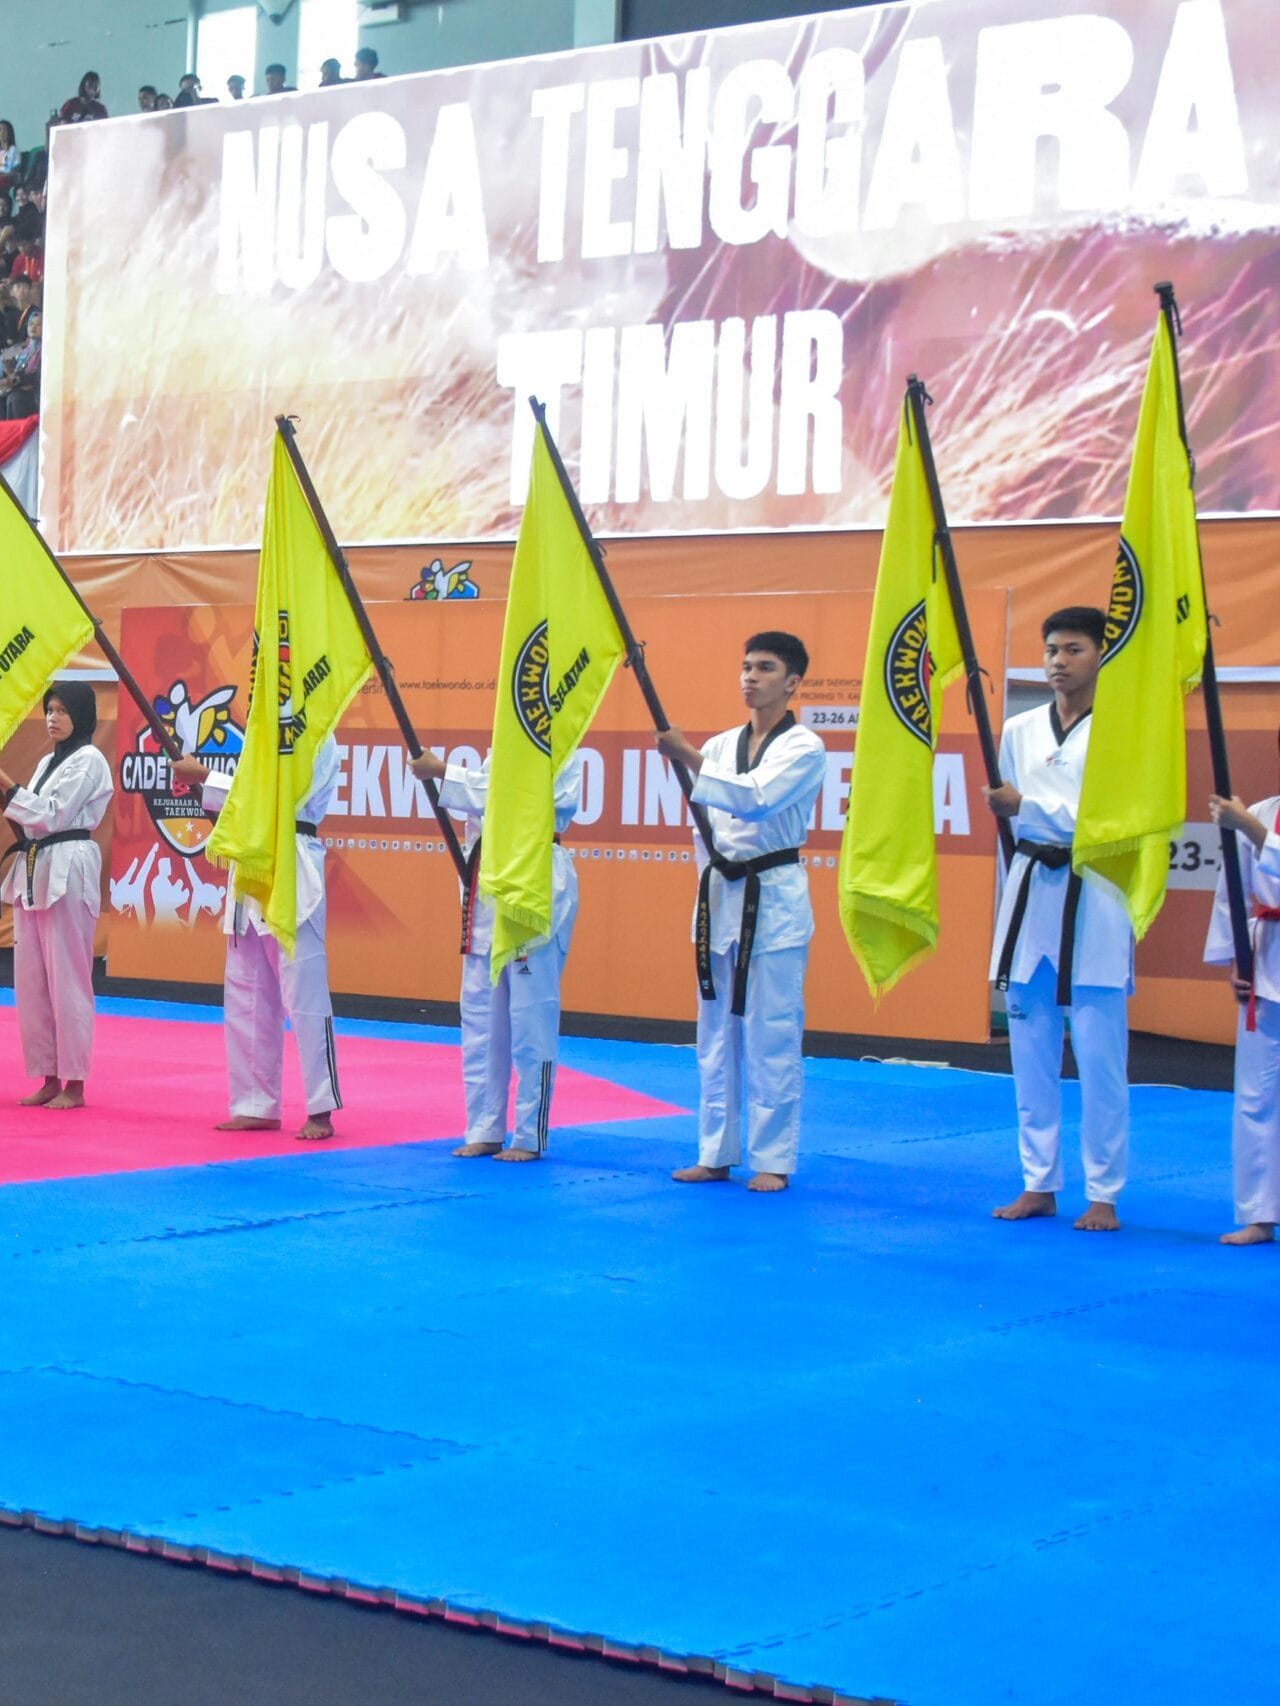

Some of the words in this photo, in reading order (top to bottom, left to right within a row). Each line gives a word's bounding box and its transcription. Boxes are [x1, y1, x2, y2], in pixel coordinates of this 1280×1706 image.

[217, 102, 489, 297] NUSA
[532, 0, 1250, 264] TENGGARA
[497, 309, 844, 507] TIMUR
[549, 647, 591, 713] SELATAN
[812, 713, 845, 724] 23-26
[164, 807, 205, 817] TAEKWON
